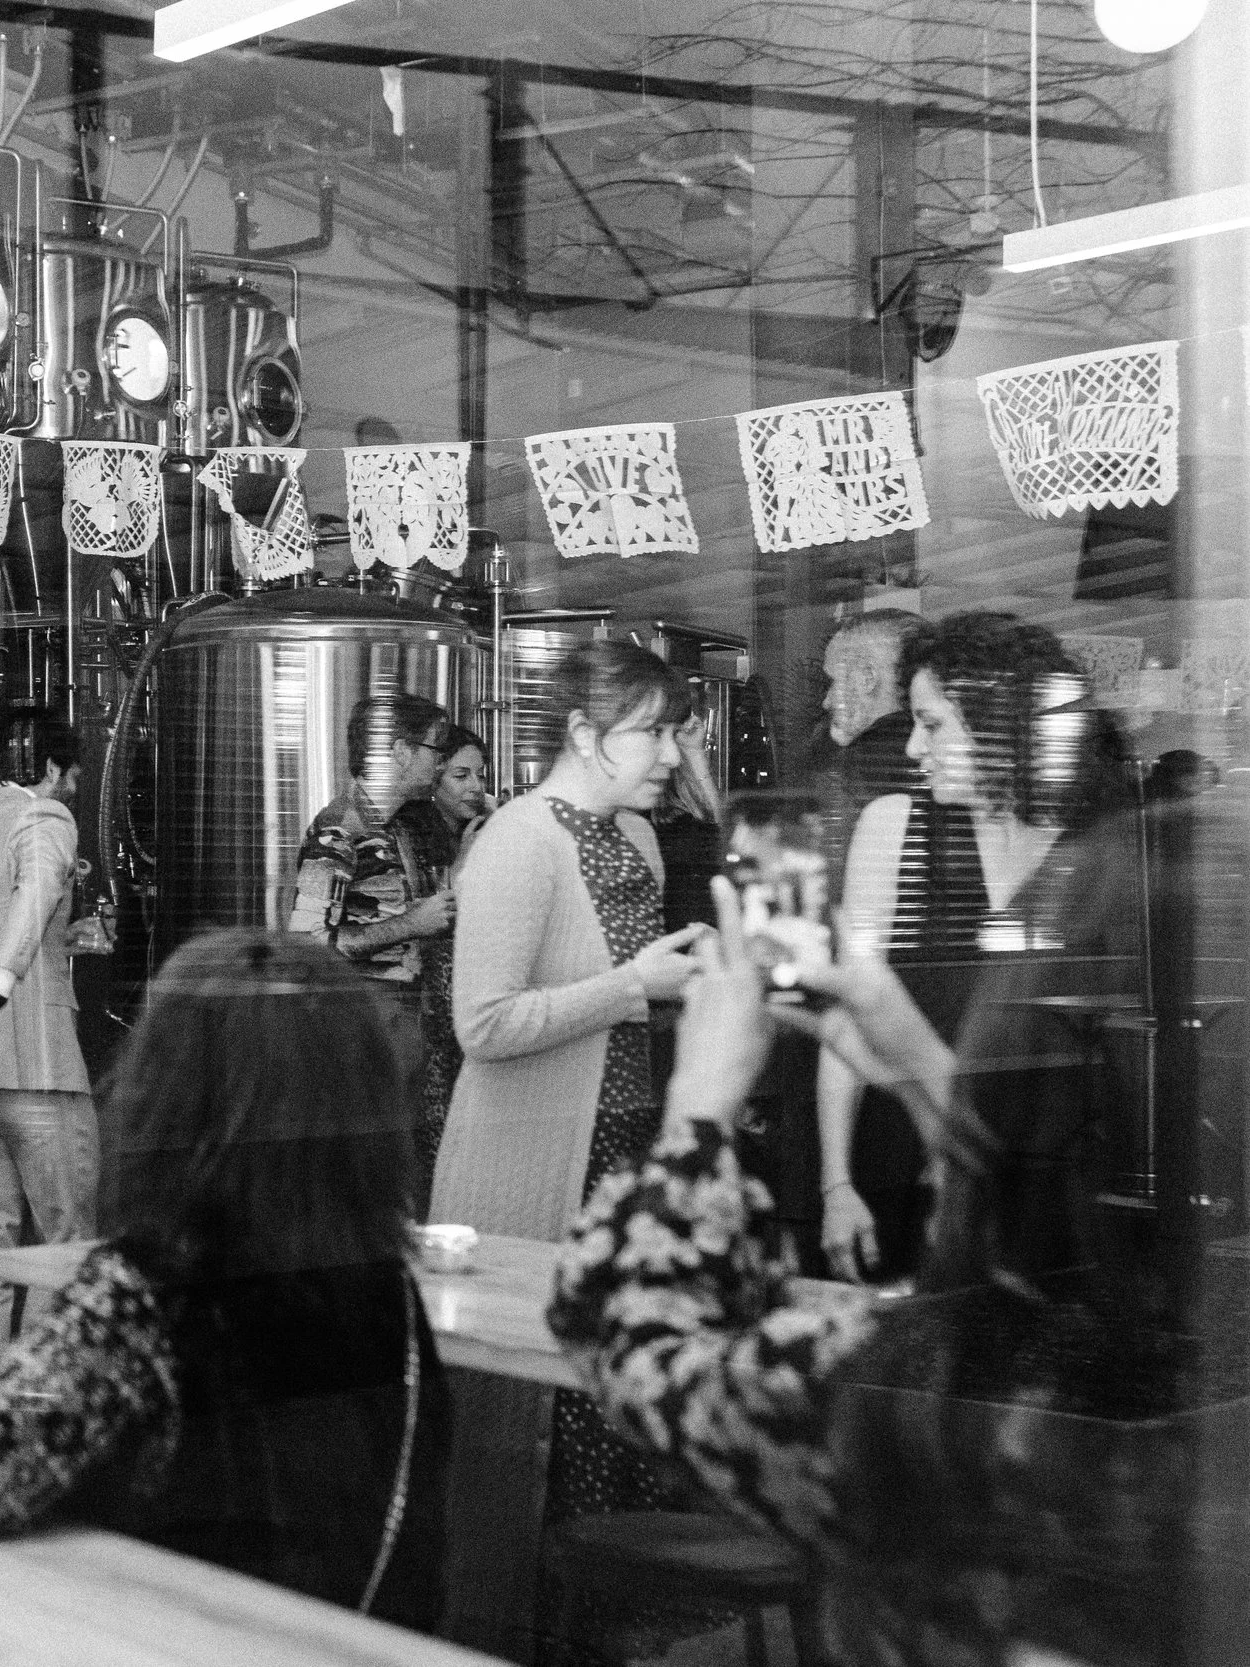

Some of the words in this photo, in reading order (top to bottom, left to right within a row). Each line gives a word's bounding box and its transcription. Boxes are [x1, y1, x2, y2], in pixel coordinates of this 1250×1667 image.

[821, 416, 867, 446] MR
[567, 454, 640, 497] LOVE
[831, 446, 888, 476] AND
[845, 473, 907, 507] MRS
